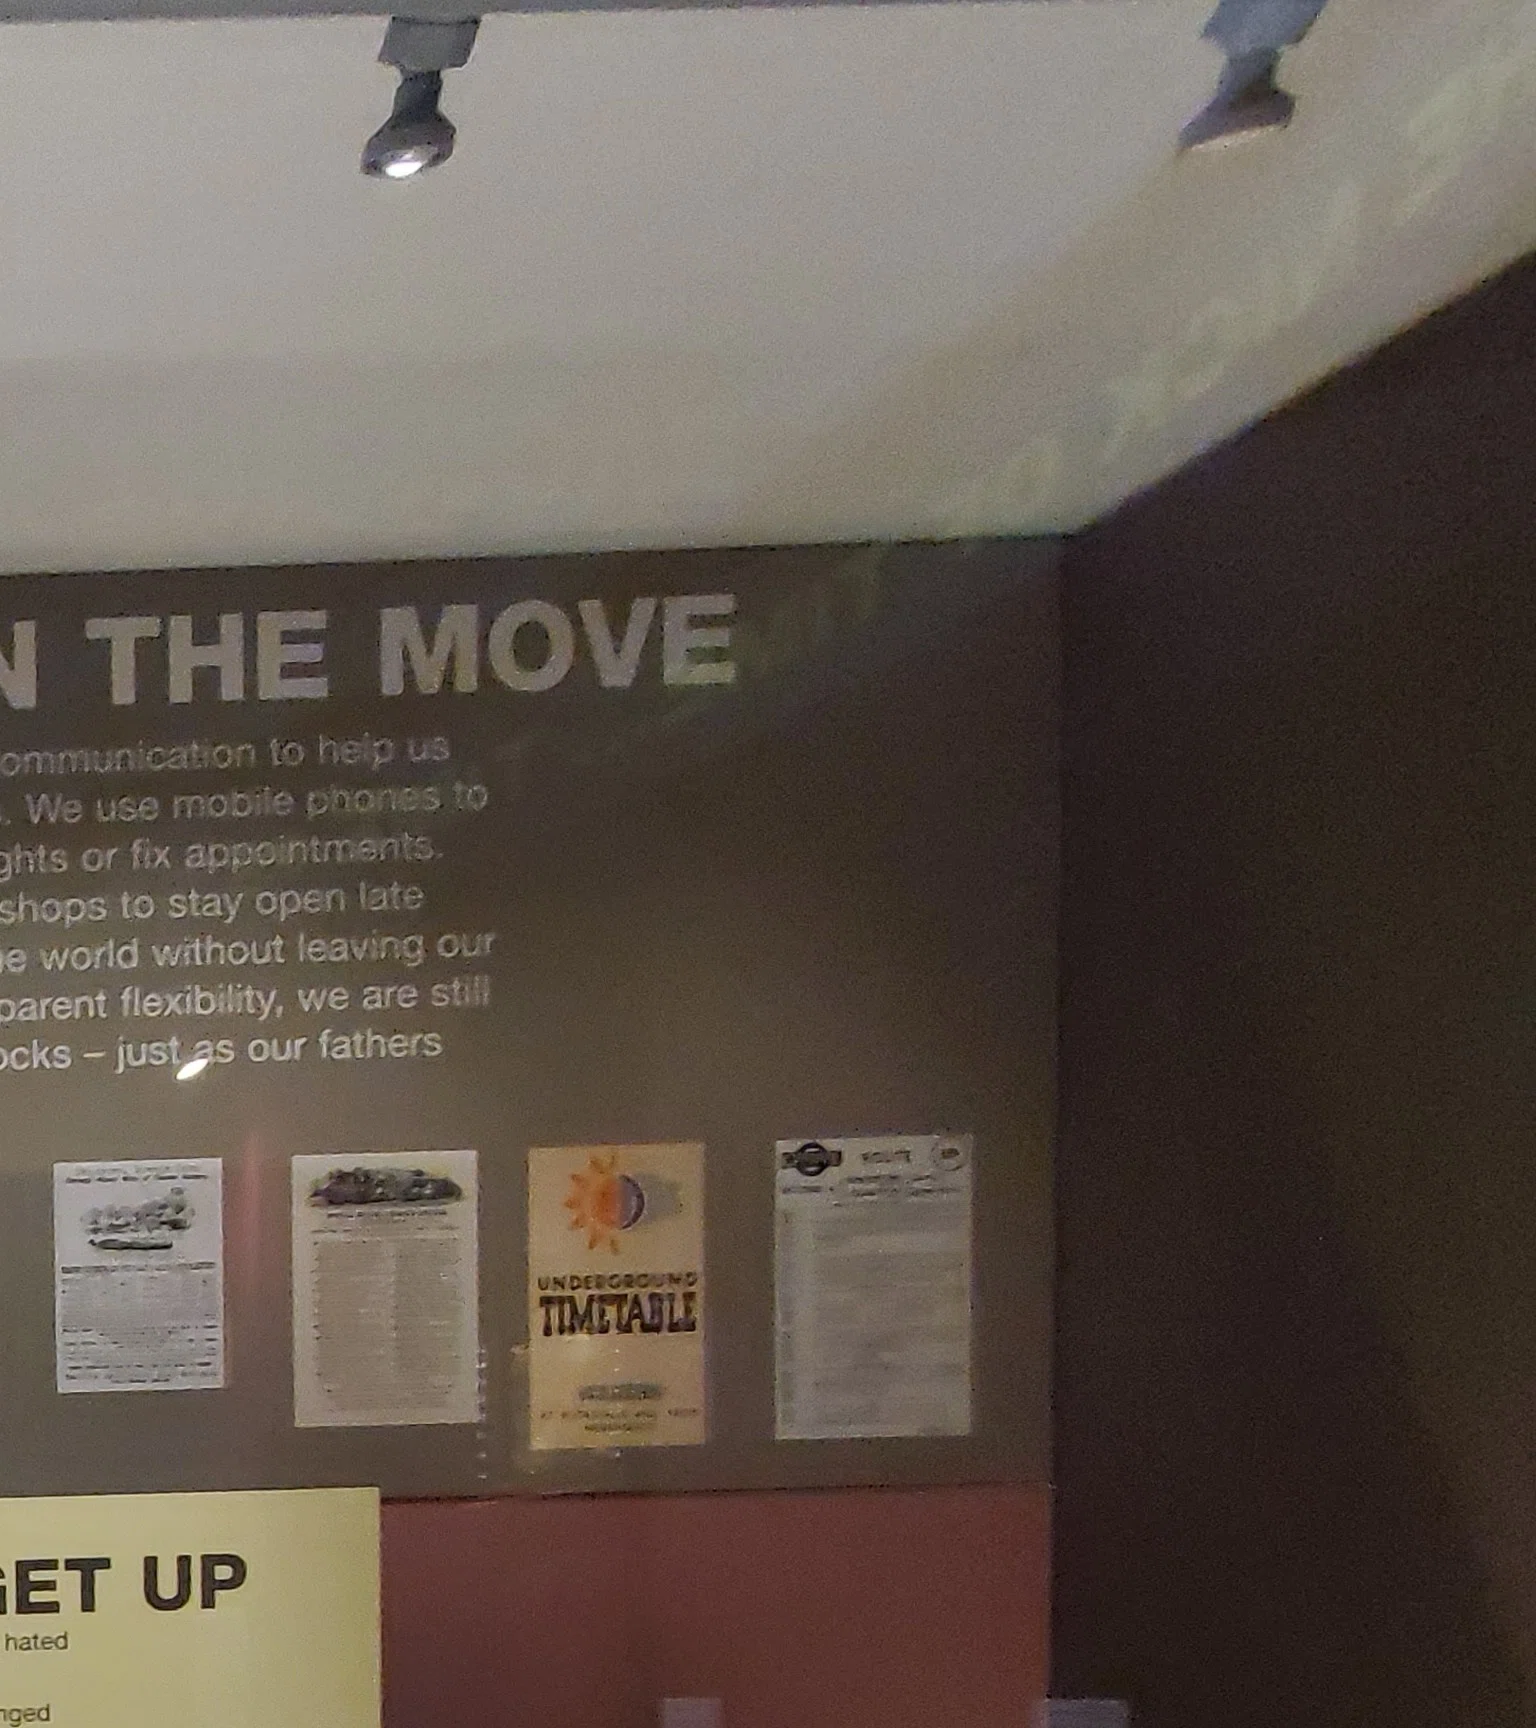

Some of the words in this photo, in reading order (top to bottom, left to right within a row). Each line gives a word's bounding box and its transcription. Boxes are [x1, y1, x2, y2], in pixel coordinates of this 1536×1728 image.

[85, 610, 328, 704] THE
[378, 593, 737, 696] MOVE
[121, 892, 155, 919] to
[168, 886, 243, 924] stay
[255, 885, 345, 920] open
[358, 881, 425, 911] late
[40, 938, 138, 972] world
[152, 935, 287, 968] without
[298, 929, 425, 966] leaving
[437, 932, 496, 959] our
[121, 986, 284, 1021] flexibility,
[297, 984, 349, 1013] we
[362, 983, 419, 1010] are
[431, 976, 491, 1008] still
[115, 1037, 181, 1074] just
[192, 1040, 236, 1066] as
[248, 1038, 307, 1062] our
[318, 1029, 444, 1059] fathers
[538, 1272, 699, 1291] UNDERGROUND
[538, 1291, 698, 1337] TIMETABLE
[142, 1552, 248, 1611] UP
[5, 1631, 69, 1651] hated
